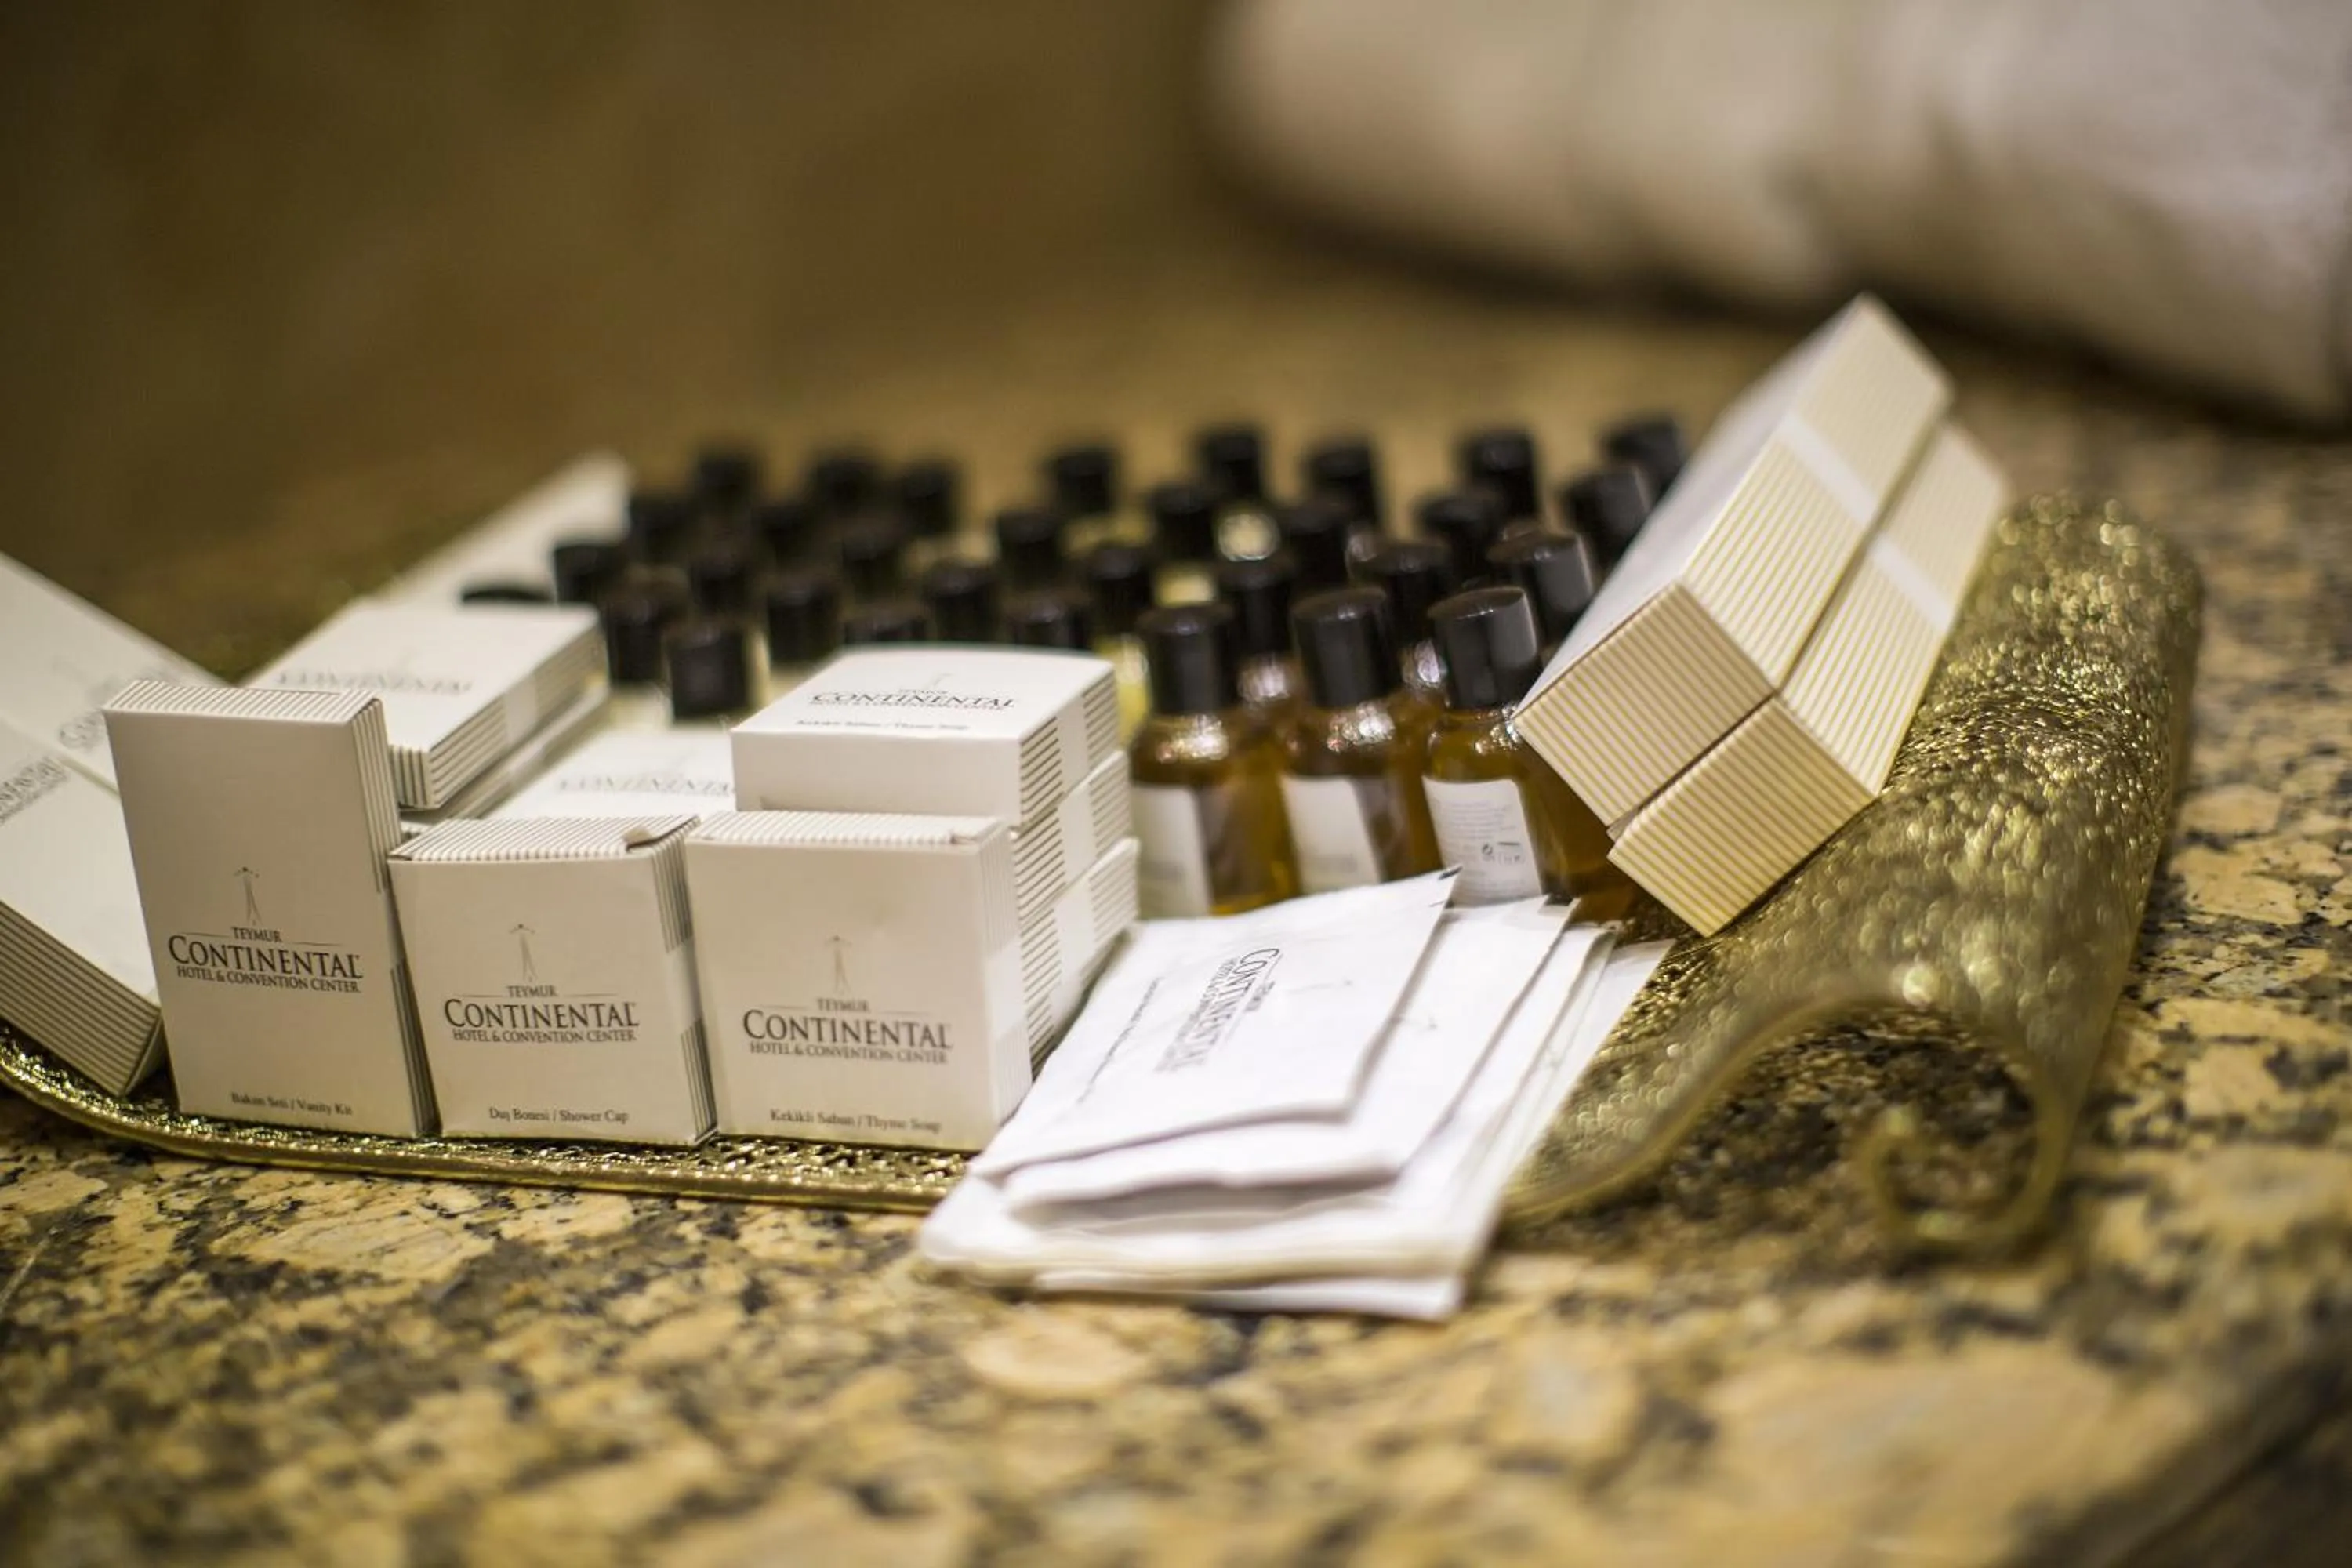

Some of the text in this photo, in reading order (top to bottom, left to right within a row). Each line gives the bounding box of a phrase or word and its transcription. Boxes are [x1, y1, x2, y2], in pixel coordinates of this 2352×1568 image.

[812, 692, 1014, 707] CONTINENTAL
[232, 927, 283, 942] TEYMUR
[167, 935, 363, 979] CONTINENTAL
[177, 966, 361, 993] HOTEL & CONVENTION CENTER
[507, 985, 558, 998] TEYMUR
[445, 998, 640, 1029] CONTINENTAL
[817, 999, 871, 1013] TEYMUR
[452, 1029, 637, 1043] HOTEL & CONVENTION CENTER
[743, 1009, 953, 1049] CONTINENTAL
[750, 1041, 948, 1064] HOTEL & CONVENTION CENTER
[513, 1108, 549, 1121] Bonesi
[559, 1109, 601, 1122] Shower
[604, 1109, 629, 1124] Cap
[865, 1115, 906, 1131] Thyme
